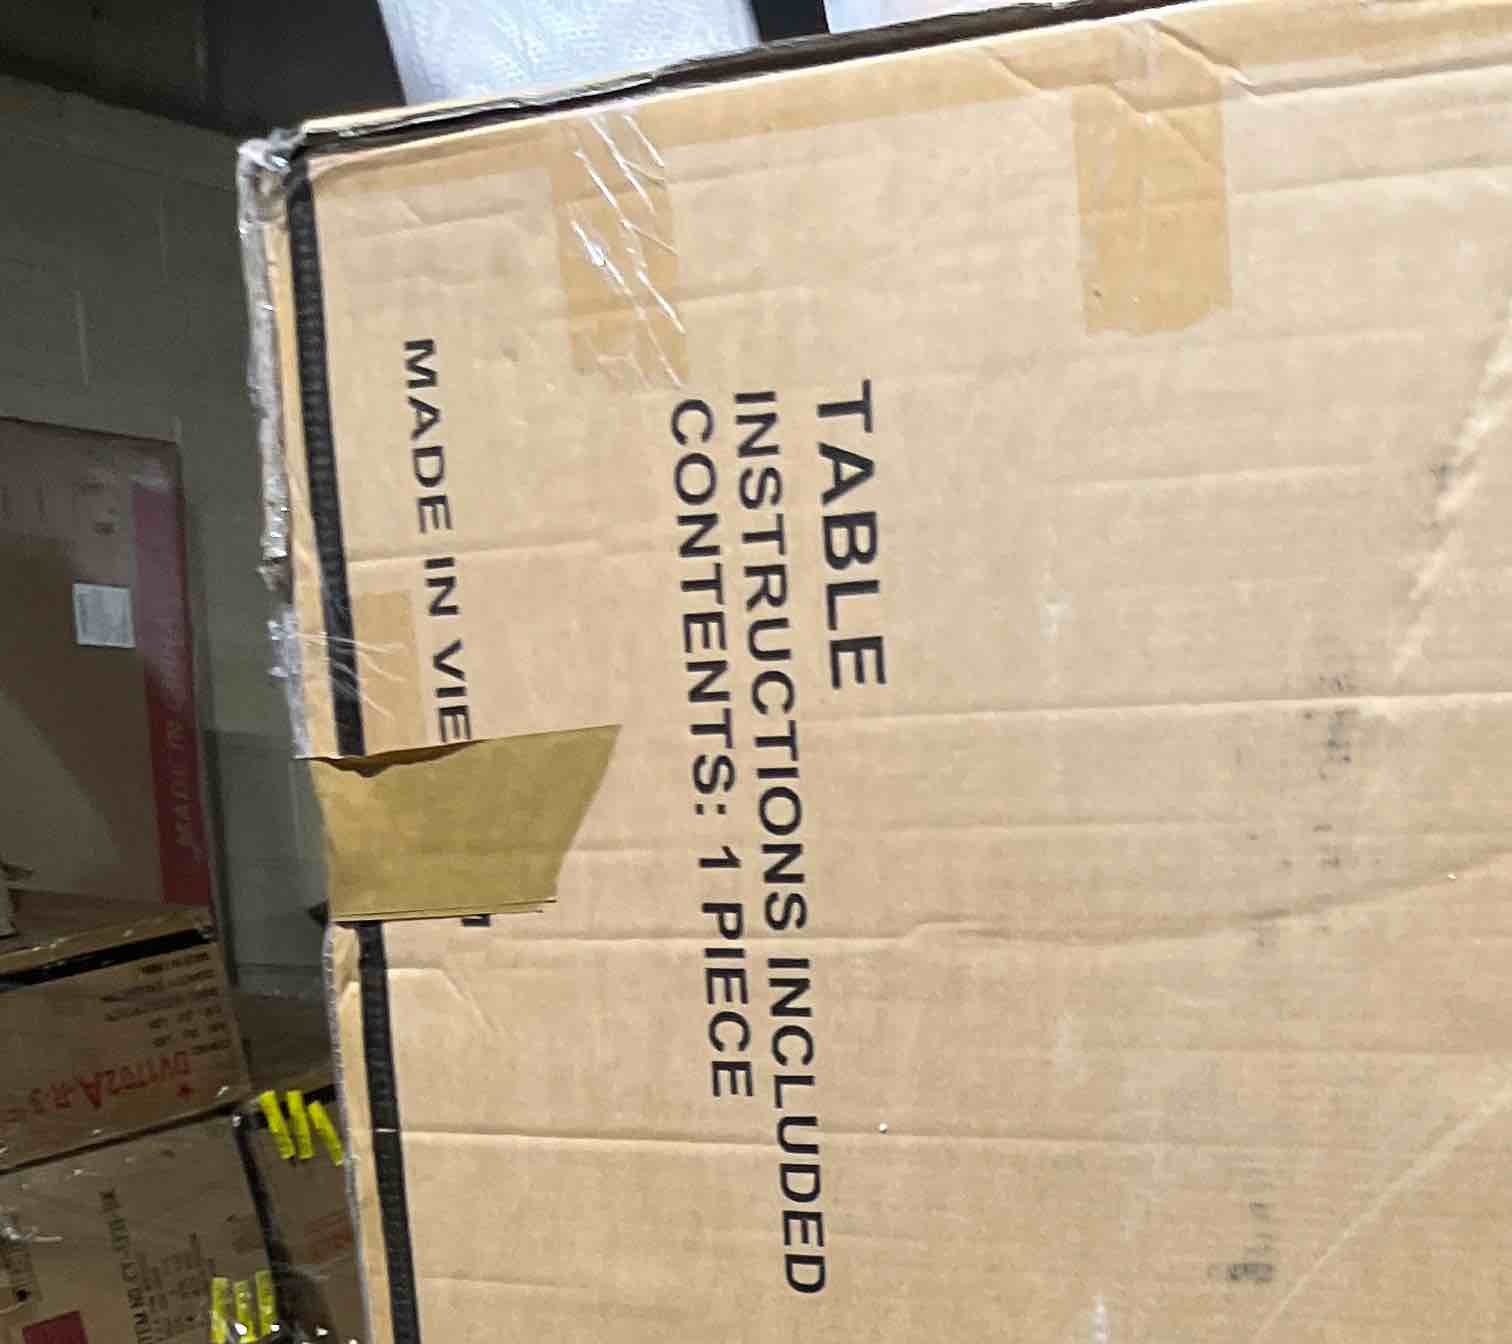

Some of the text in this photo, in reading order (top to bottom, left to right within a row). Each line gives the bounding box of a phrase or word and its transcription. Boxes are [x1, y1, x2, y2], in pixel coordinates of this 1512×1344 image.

[405, 339, 451, 532] MADE
[425, 557, 458, 616] IN
[818, 380, 885, 689] TABLE
[672, 400, 752, 1096] CONTENTS: 1 PIECE
[733, 389, 825, 1293] INSTRUCTIONS INCLUDED
